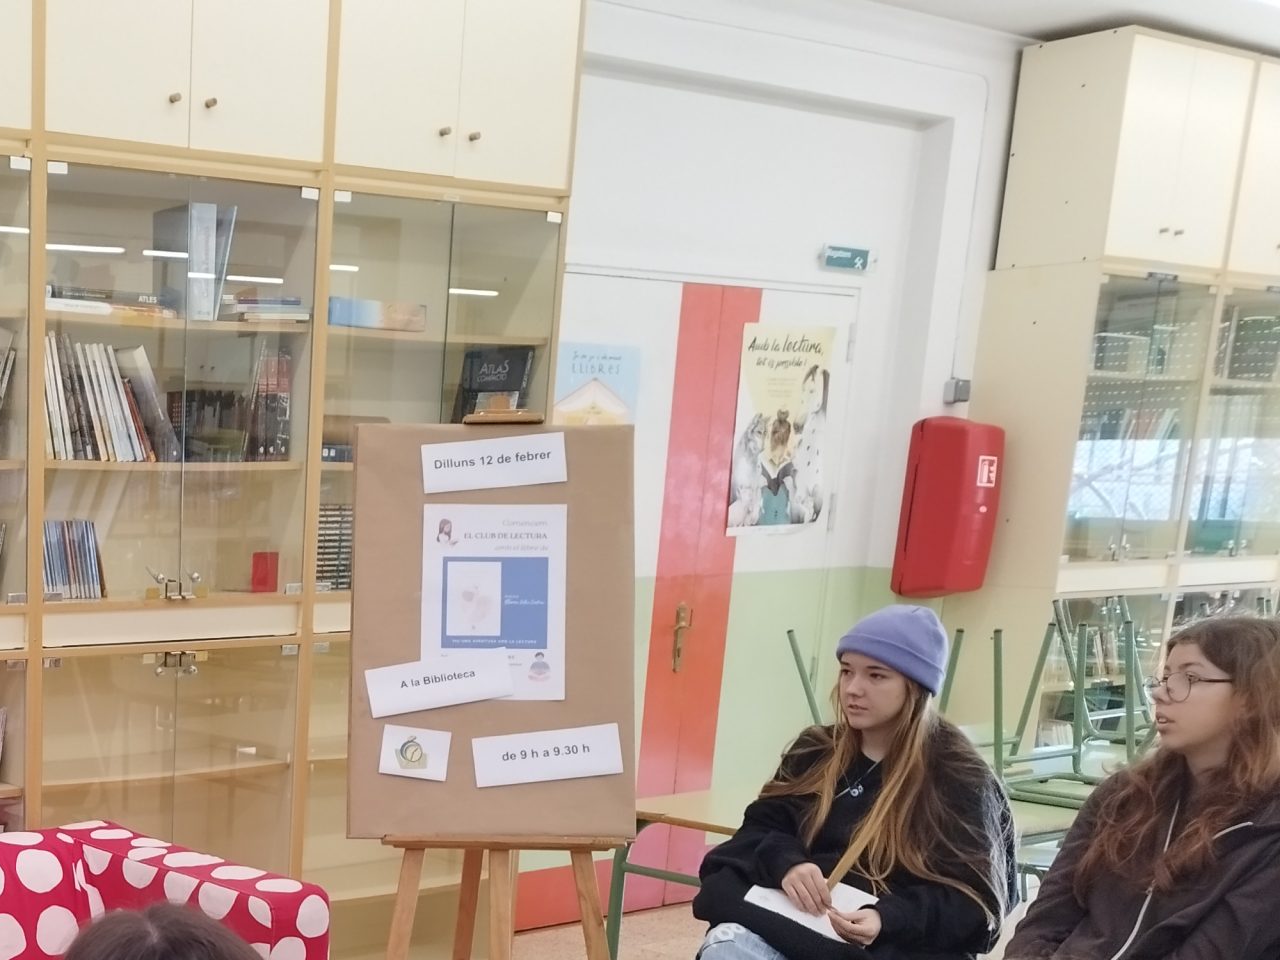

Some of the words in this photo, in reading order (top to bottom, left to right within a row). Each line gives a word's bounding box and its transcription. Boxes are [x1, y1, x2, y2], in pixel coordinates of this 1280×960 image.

[748, 337, 770, 352] Amb
[771, 338, 780, 352] la
[479, 360, 510, 375] ATLAS
[434, 457, 476, 469] Dilluns
[480, 455, 493, 466] 12
[496, 454, 512, 464] de
[515, 451, 551, 462] febrer
[509, 532, 548, 540] LECTURA
[400, 680, 409, 688] A
[411, 678, 420, 687] la
[423, 669, 476, 685] Biblioteca
[502, 752, 517, 761] de
[520, 750, 527, 759] 9
[531, 749, 539, 758] h
[542, 749, 550, 758] a
[553, 744, 578, 757] 9.30
[582, 743, 590, 753] h
